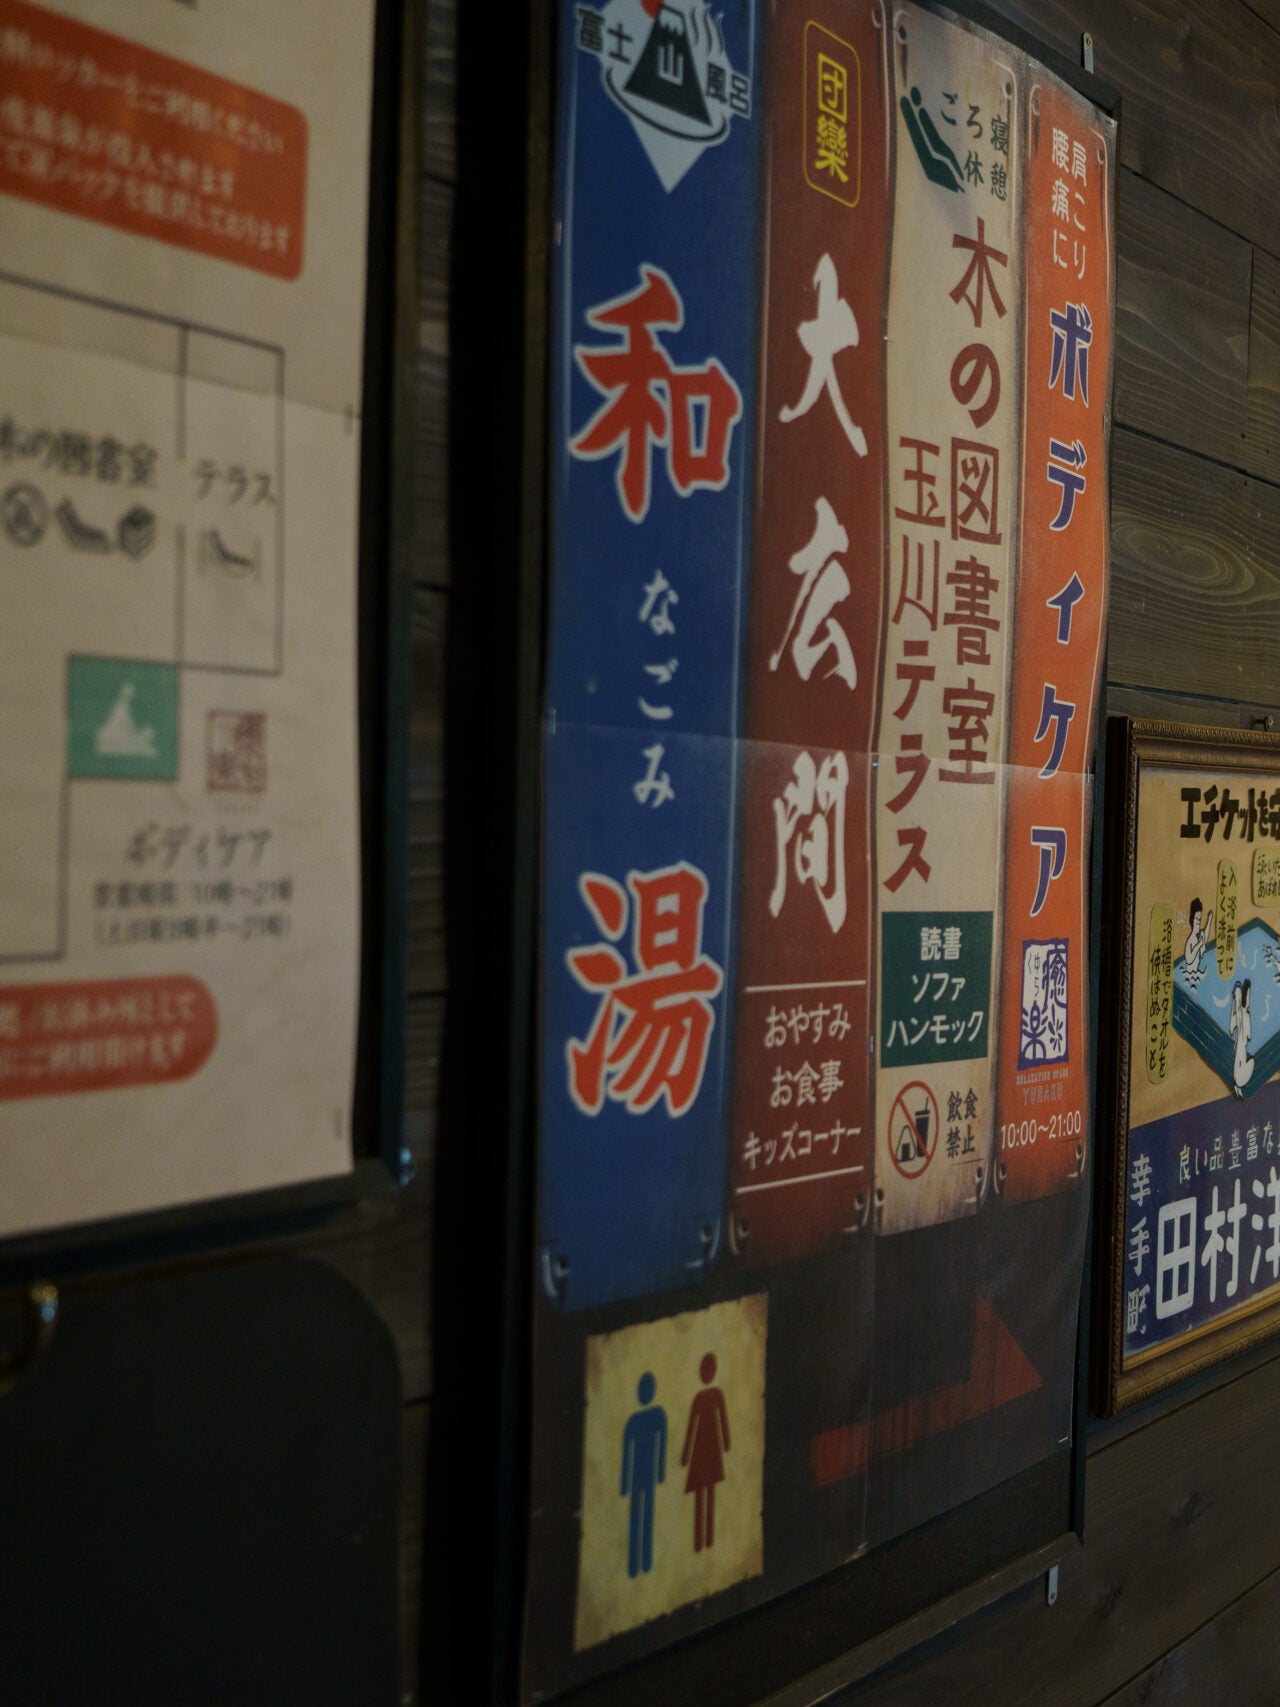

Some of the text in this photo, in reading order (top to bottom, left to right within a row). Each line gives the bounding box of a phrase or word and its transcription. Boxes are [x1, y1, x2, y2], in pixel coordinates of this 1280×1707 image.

[656, 42, 684, 87] 山
[815, 52, 849, 183] 団欒
[963, 150, 1008, 201] 休憩
[1051, 127, 1070, 269] 腰痛に
[1072, 140, 1088, 281] 肩こり
[567, 262, 743, 524] 和
[938, 216, 1009, 786] 木の図書室
[768, 252, 869, 934] 大広間
[631, 568, 681, 808] なごみ
[883, 436, 946, 894] 玉川テラス
[920, 926, 962, 961] 読書
[565, 860, 724, 1118] 湯
[911, 971, 966, 1004] ソファ
[764, 1003, 851, 1048] おやすみ
[886, 1010, 984, 1048] ハンモック
[770, 1059, 844, 1108] お食事
[946, 1088, 978, 1122] 飲食
[743, 1119, 862, 1170] キッズコーナー
[946, 1124, 976, 1158] 禁止
